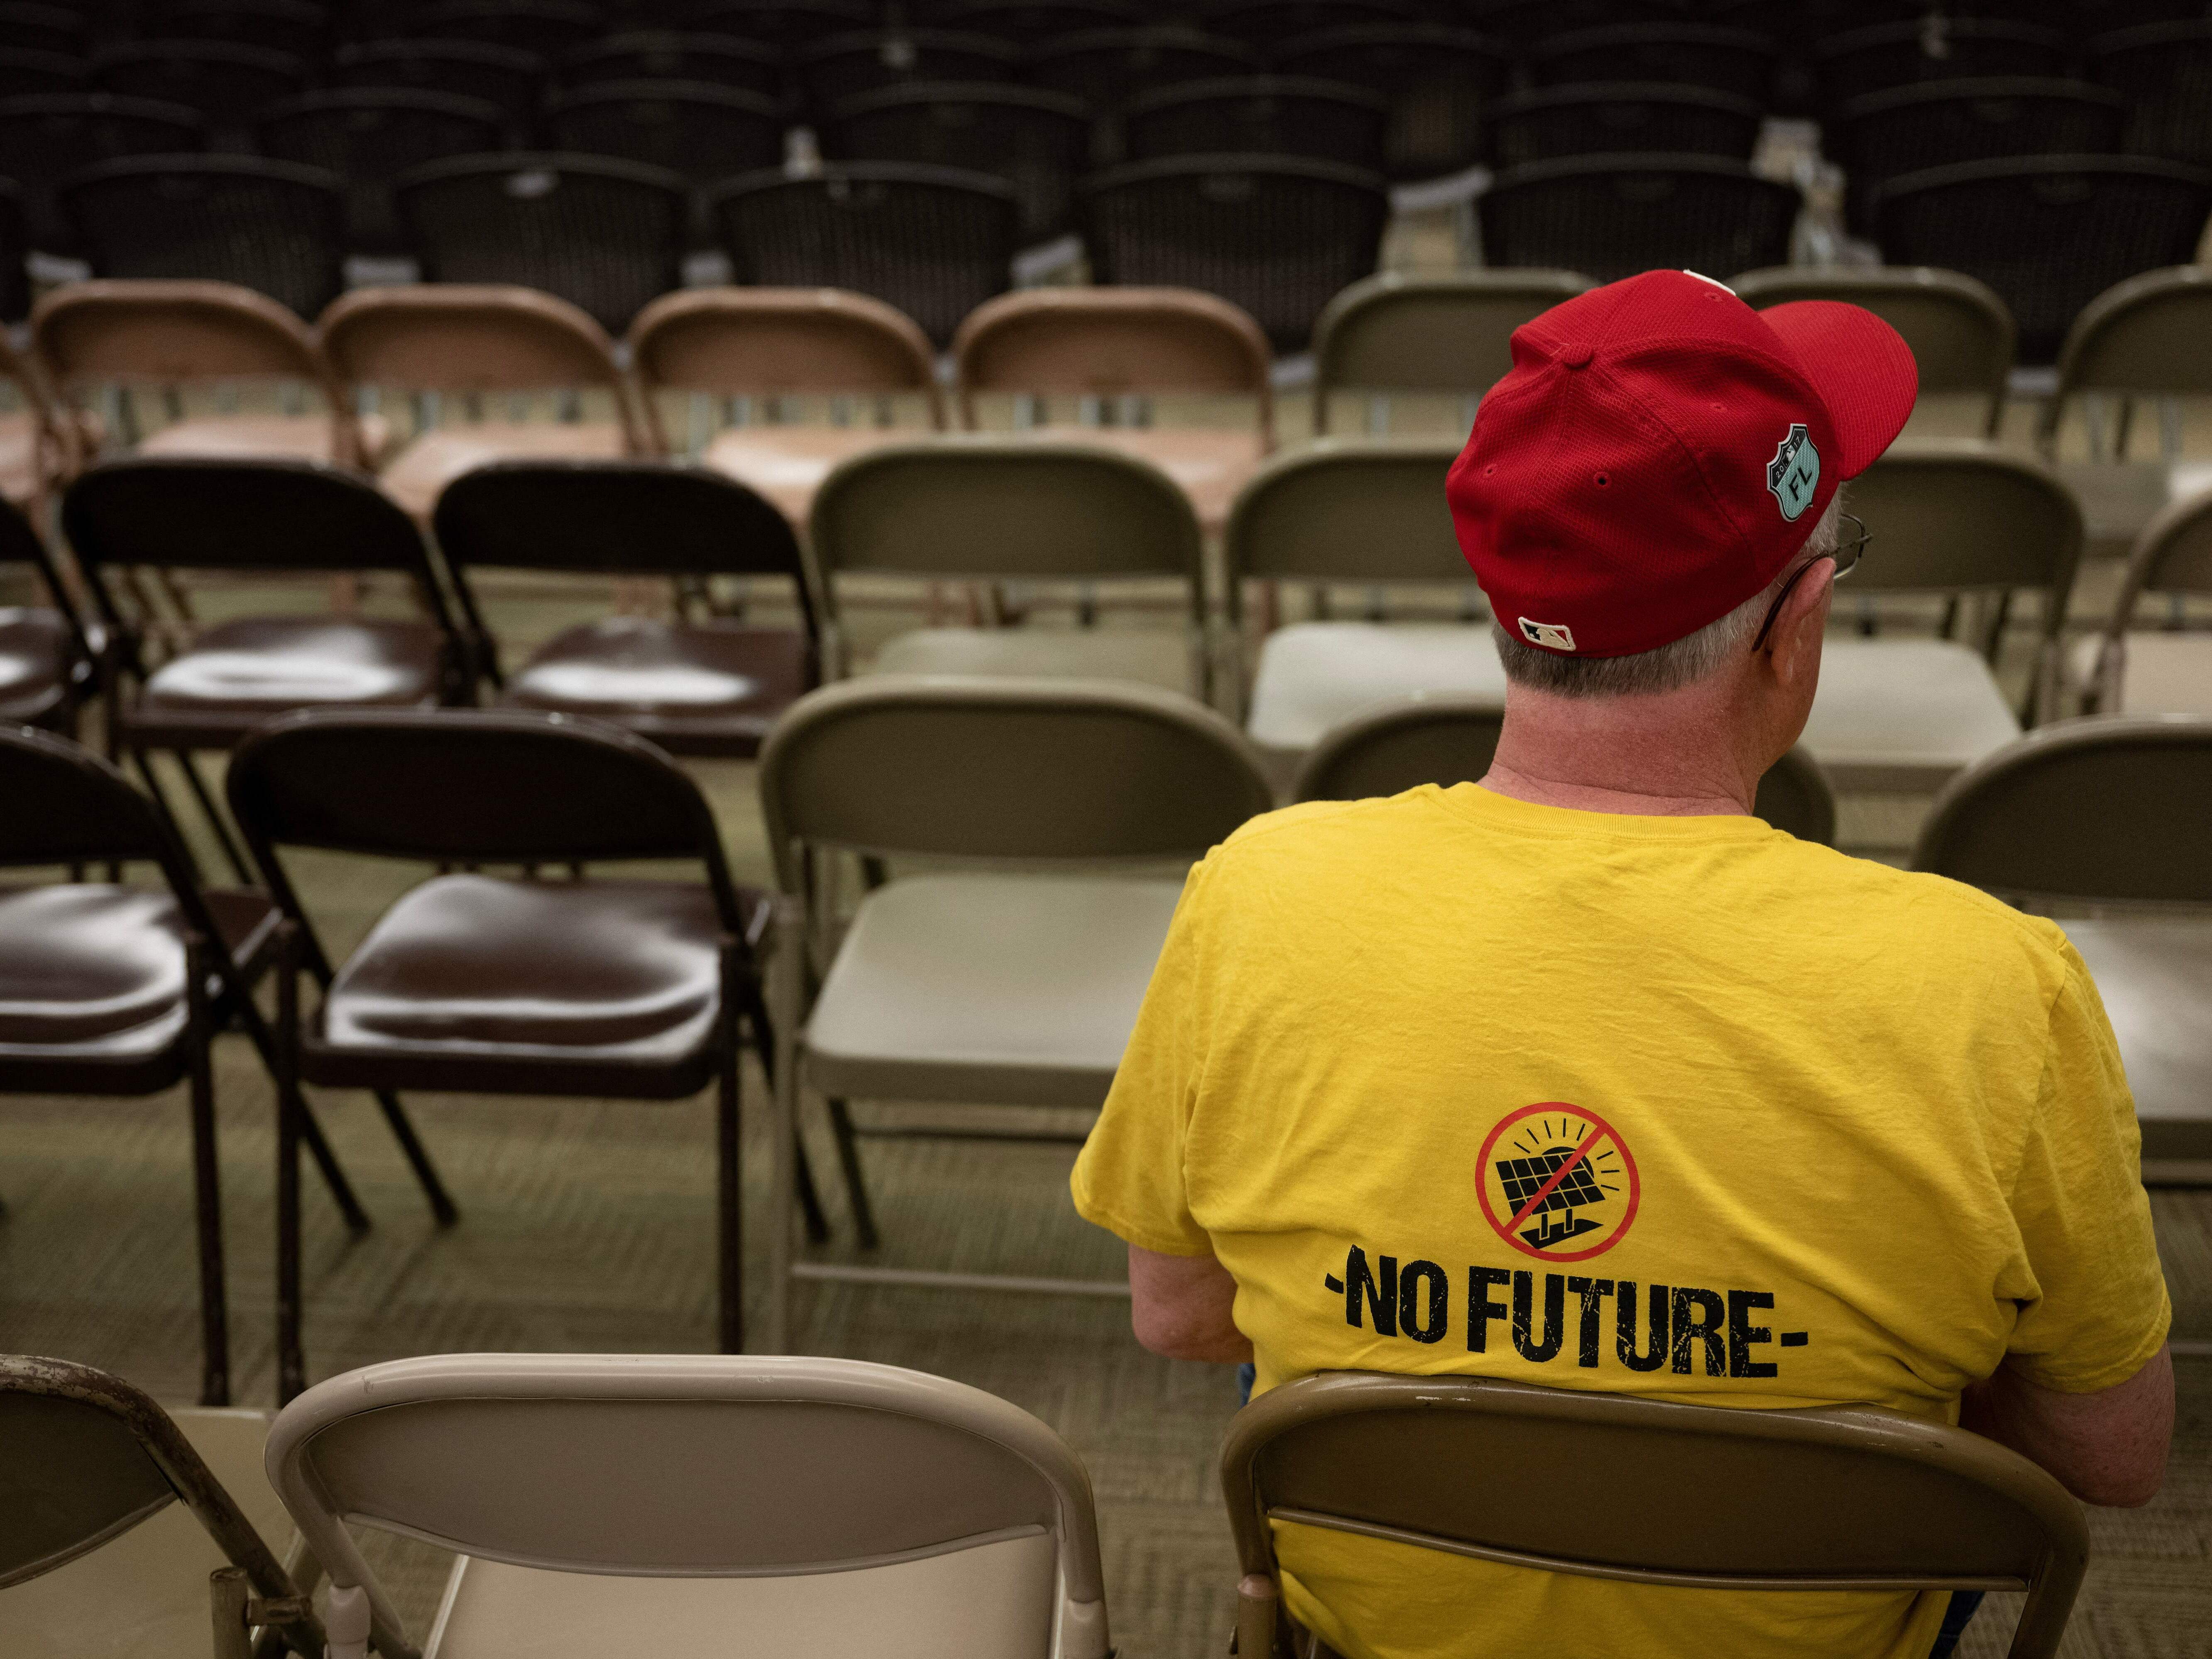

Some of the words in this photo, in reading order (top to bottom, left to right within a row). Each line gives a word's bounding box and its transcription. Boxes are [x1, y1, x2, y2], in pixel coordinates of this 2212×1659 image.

[1776, 465, 1784, 479] 20
[1794, 436, 1800, 448] 17
[1789, 465, 1813, 502] FL
